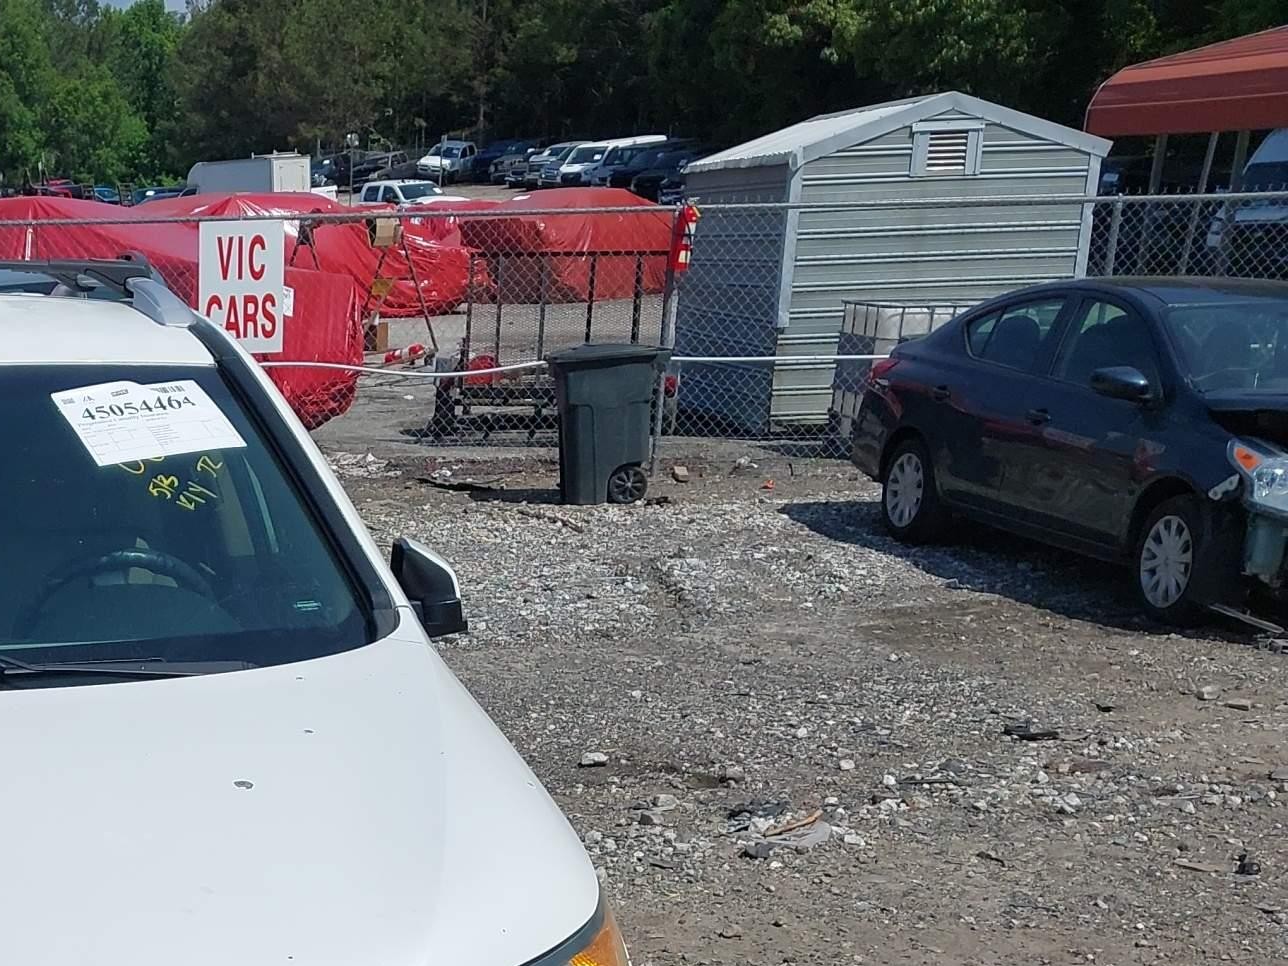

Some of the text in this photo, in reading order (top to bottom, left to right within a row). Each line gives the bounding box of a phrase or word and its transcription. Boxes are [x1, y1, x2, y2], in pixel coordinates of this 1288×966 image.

[216, 234, 266, 281] VIC
[205, 293, 277, 339] CARS
[81, 394, 197, 421] 45054464
